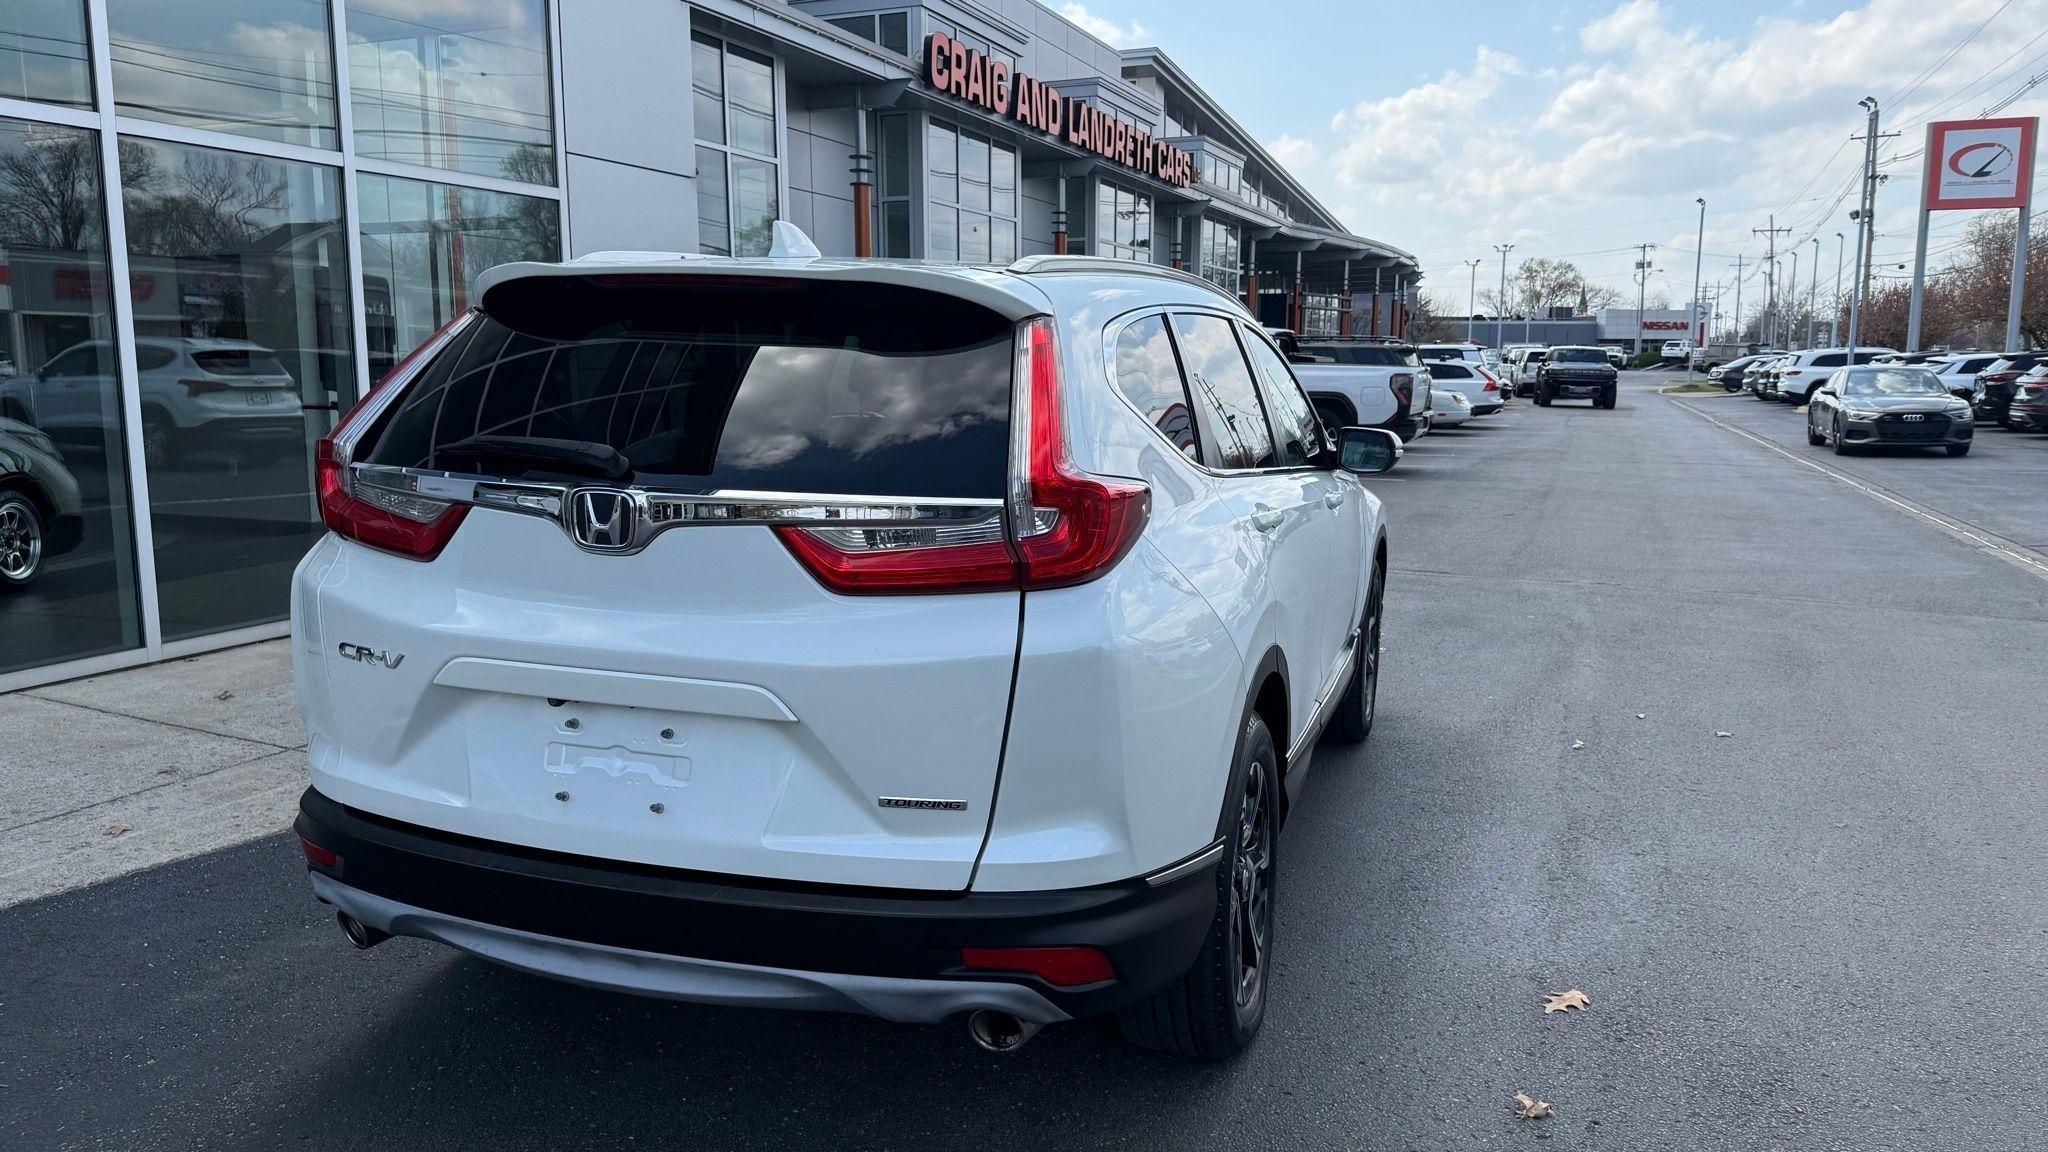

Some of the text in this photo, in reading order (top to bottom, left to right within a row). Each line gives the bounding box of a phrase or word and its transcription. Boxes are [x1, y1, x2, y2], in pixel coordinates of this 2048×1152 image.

[929, 31, 1191, 188] CRAIG AND LANDRETH CARS
[1642, 321, 1689, 331] NISSAN
[339, 642, 406, 669] CR-V
[883, 798, 963, 810] TOURING
